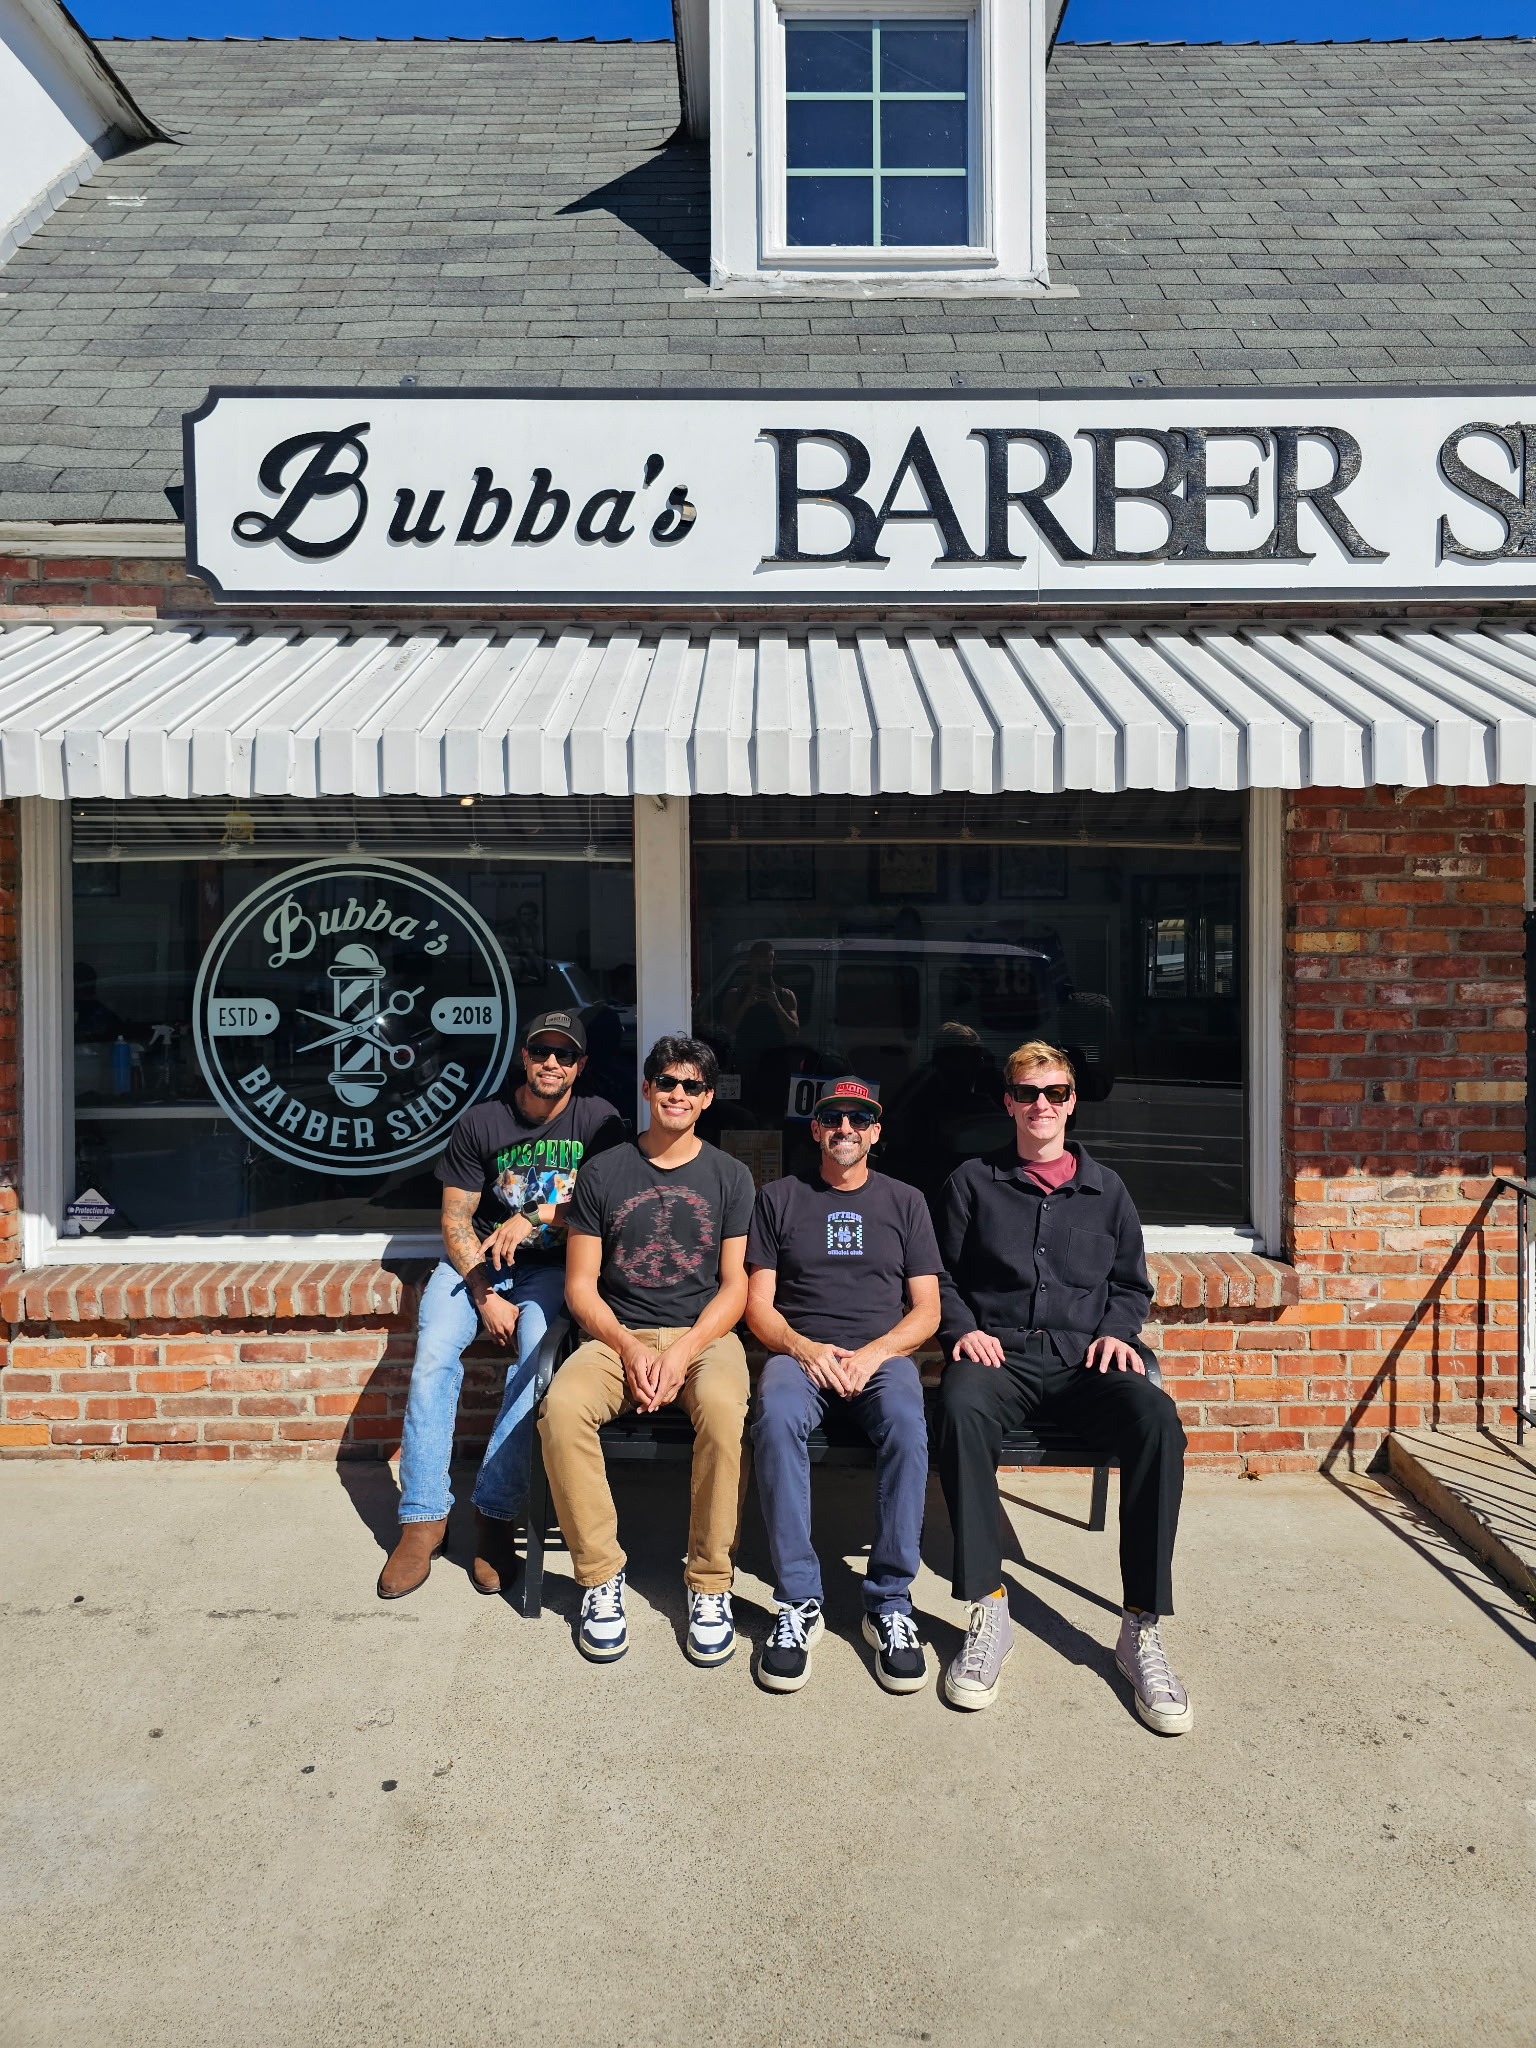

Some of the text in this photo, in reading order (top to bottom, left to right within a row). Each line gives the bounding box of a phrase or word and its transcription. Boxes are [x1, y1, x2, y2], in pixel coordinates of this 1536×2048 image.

[232, 420, 1536, 564] Bubba's BARBER S
[263, 893, 449, 968] Bubba's
[219, 1007, 258, 1027] ESTD
[452, 1006, 493, 1025] 2018
[238, 1061, 470, 1149] BARBER SHOP
[74, 1206, 116, 1215] Protection One
[827, 1211, 863, 1223] FIFTEEN
